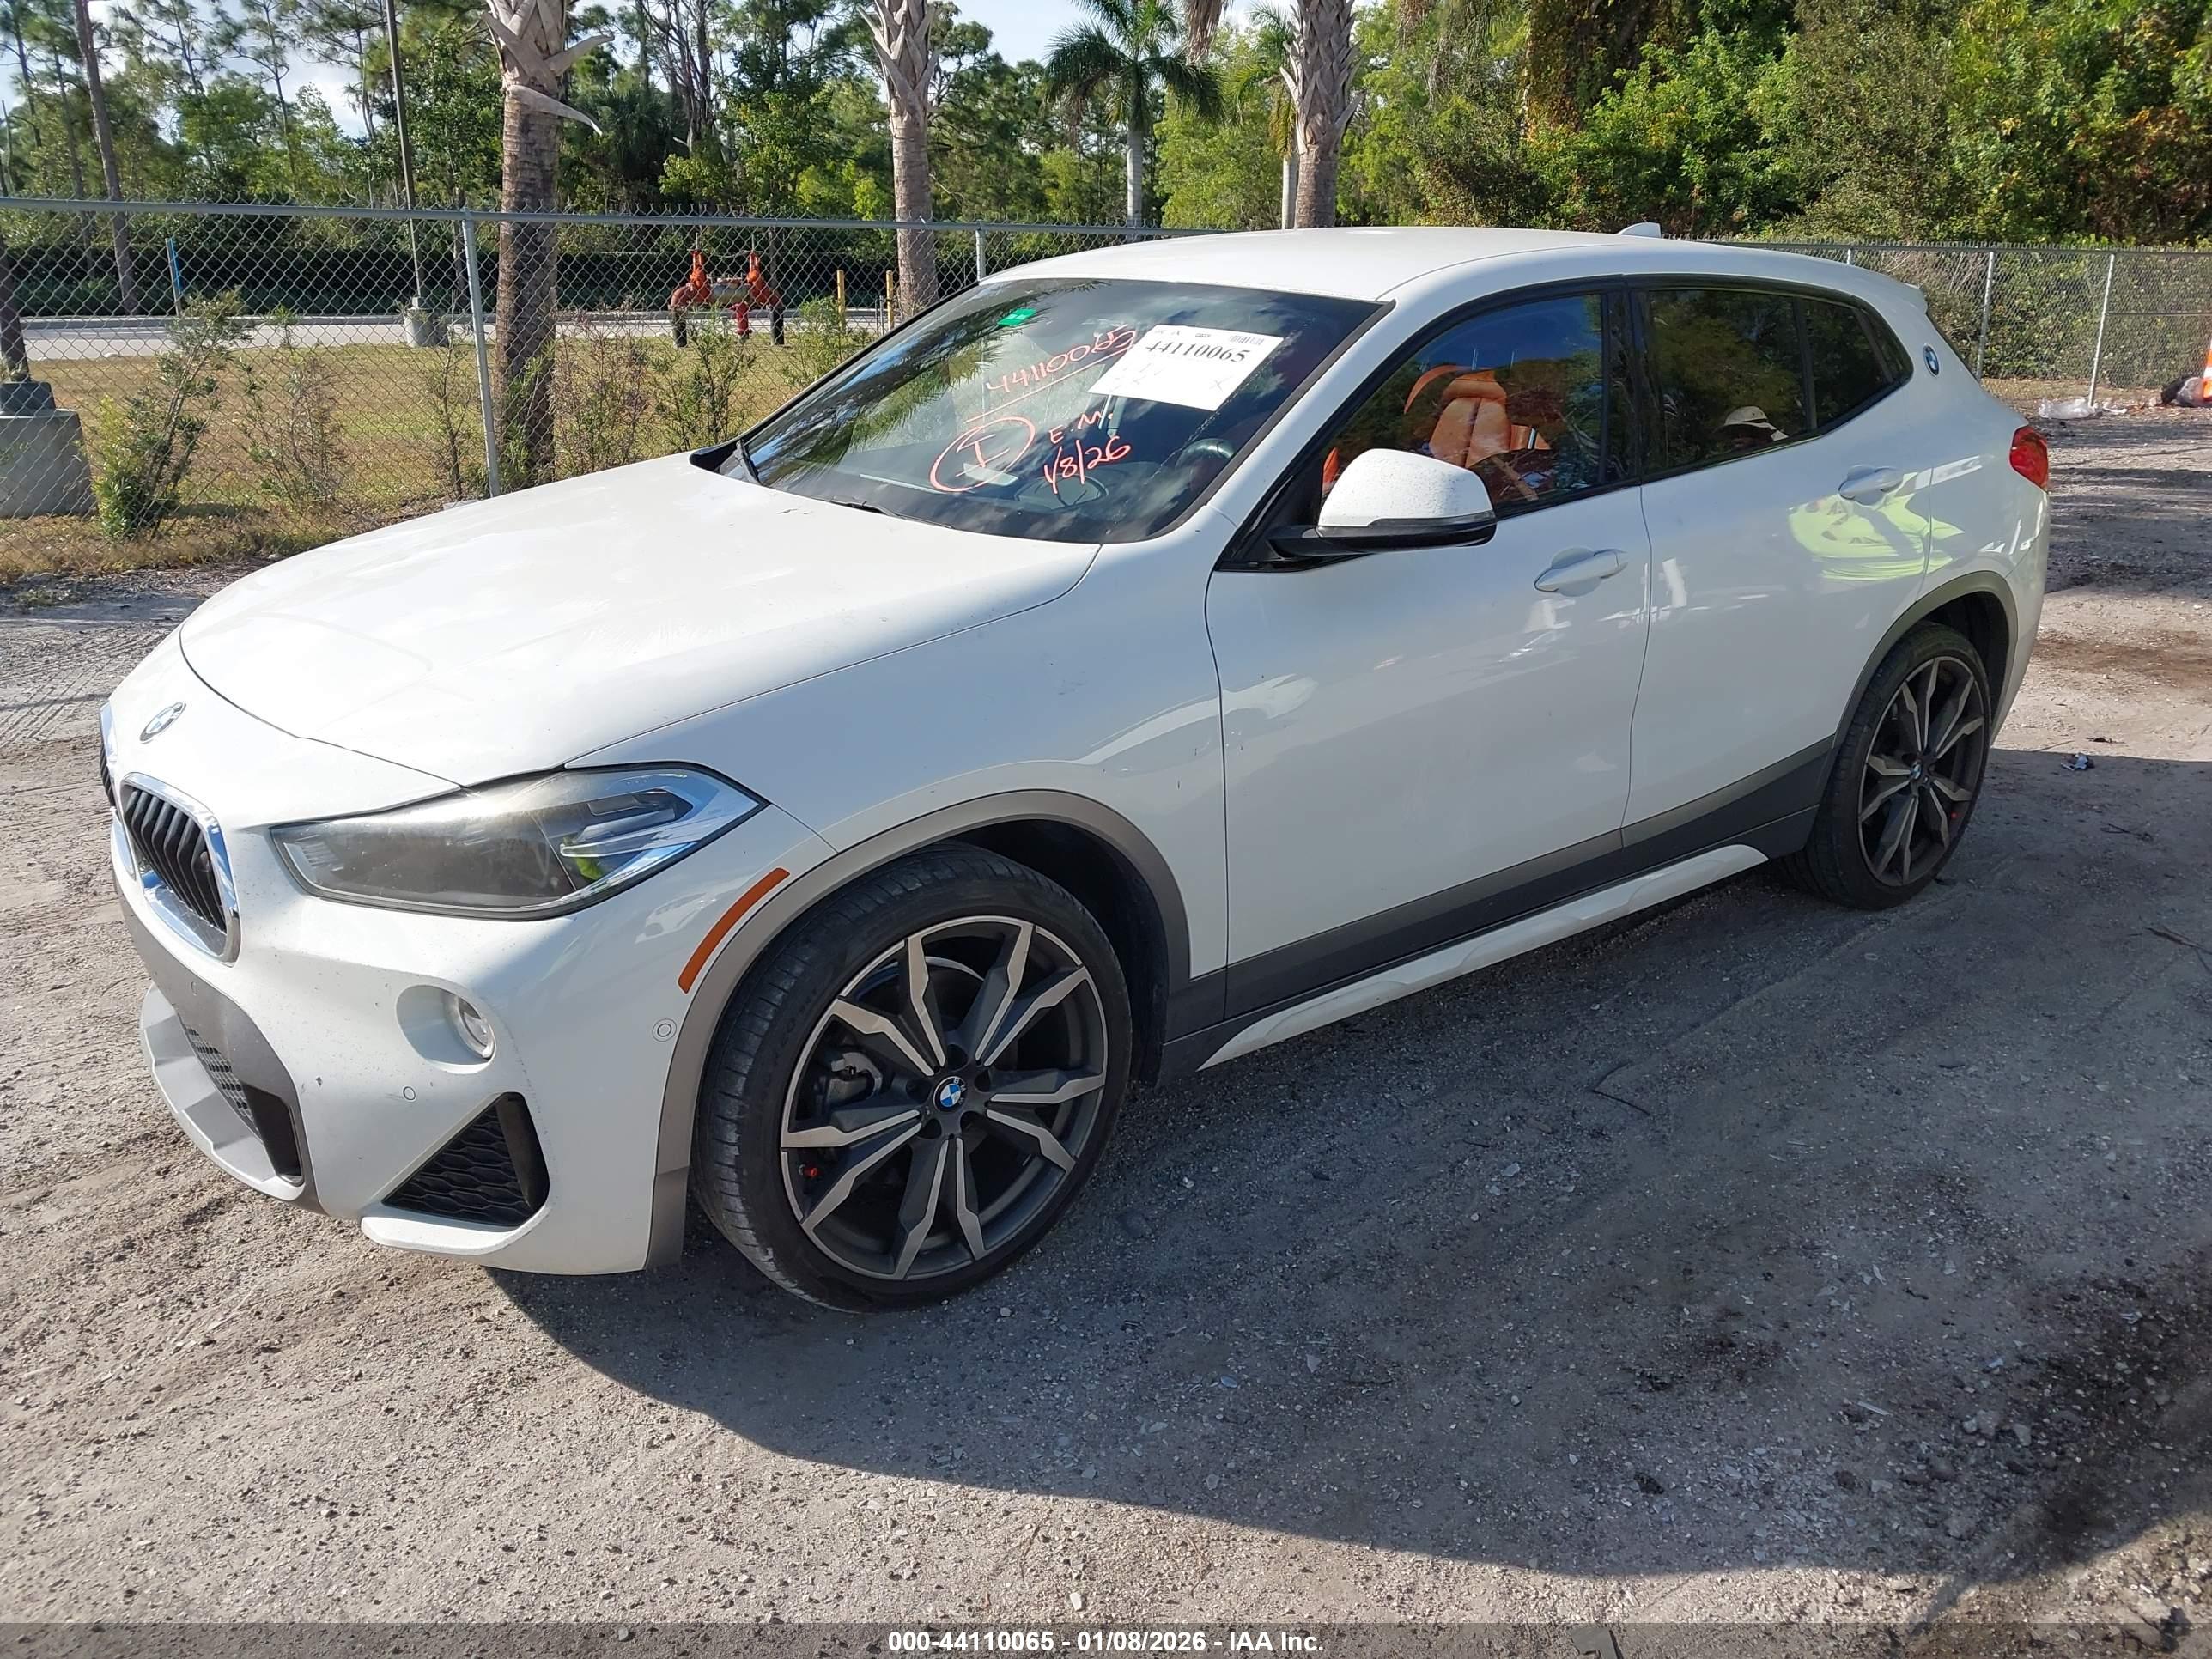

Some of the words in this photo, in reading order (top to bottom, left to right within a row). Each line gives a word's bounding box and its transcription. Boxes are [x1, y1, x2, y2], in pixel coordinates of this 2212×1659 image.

[986, 324, 1136, 392] 44110065
[1146, 340, 1251, 362] 44110065
[1043, 435, 1132, 495] 1/8/26
